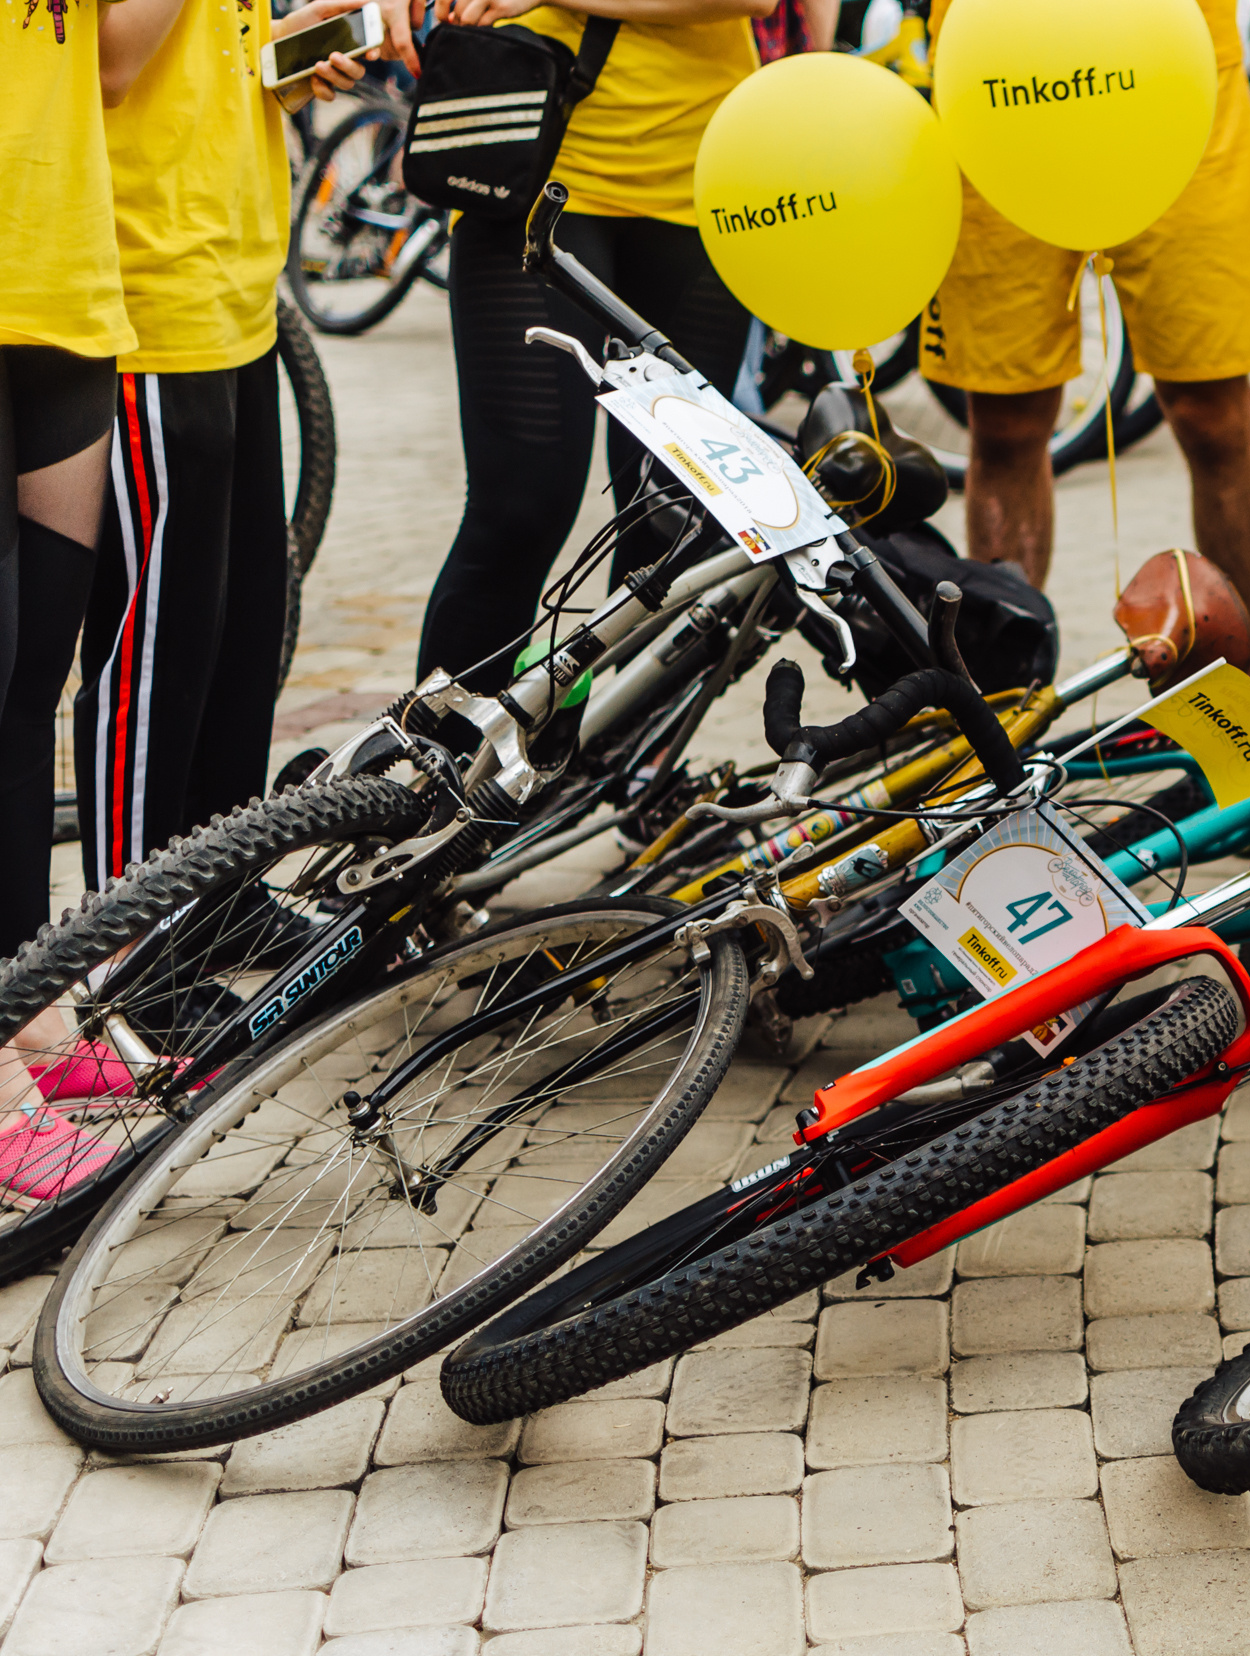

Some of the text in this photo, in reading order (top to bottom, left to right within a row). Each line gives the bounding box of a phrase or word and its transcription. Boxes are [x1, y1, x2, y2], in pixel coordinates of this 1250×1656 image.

[983, 67, 1136, 109] Tinkoff.ru
[446, 174, 491, 196] adidas
[710, 190, 838, 236] Tinkoff.ru
[671, 446, 715, 492] Tinkoff.ru
[700, 438, 765, 485] 43
[965, 901, 1039, 977] #пятигорскийвелопарад2
[1005, 891, 1074, 945] 47
[966, 934, 1008, 980] Tinkoff.ru
[251, 925, 363, 1039] SR SUNTOUR
[731, 1154, 791, 1192] IKON
